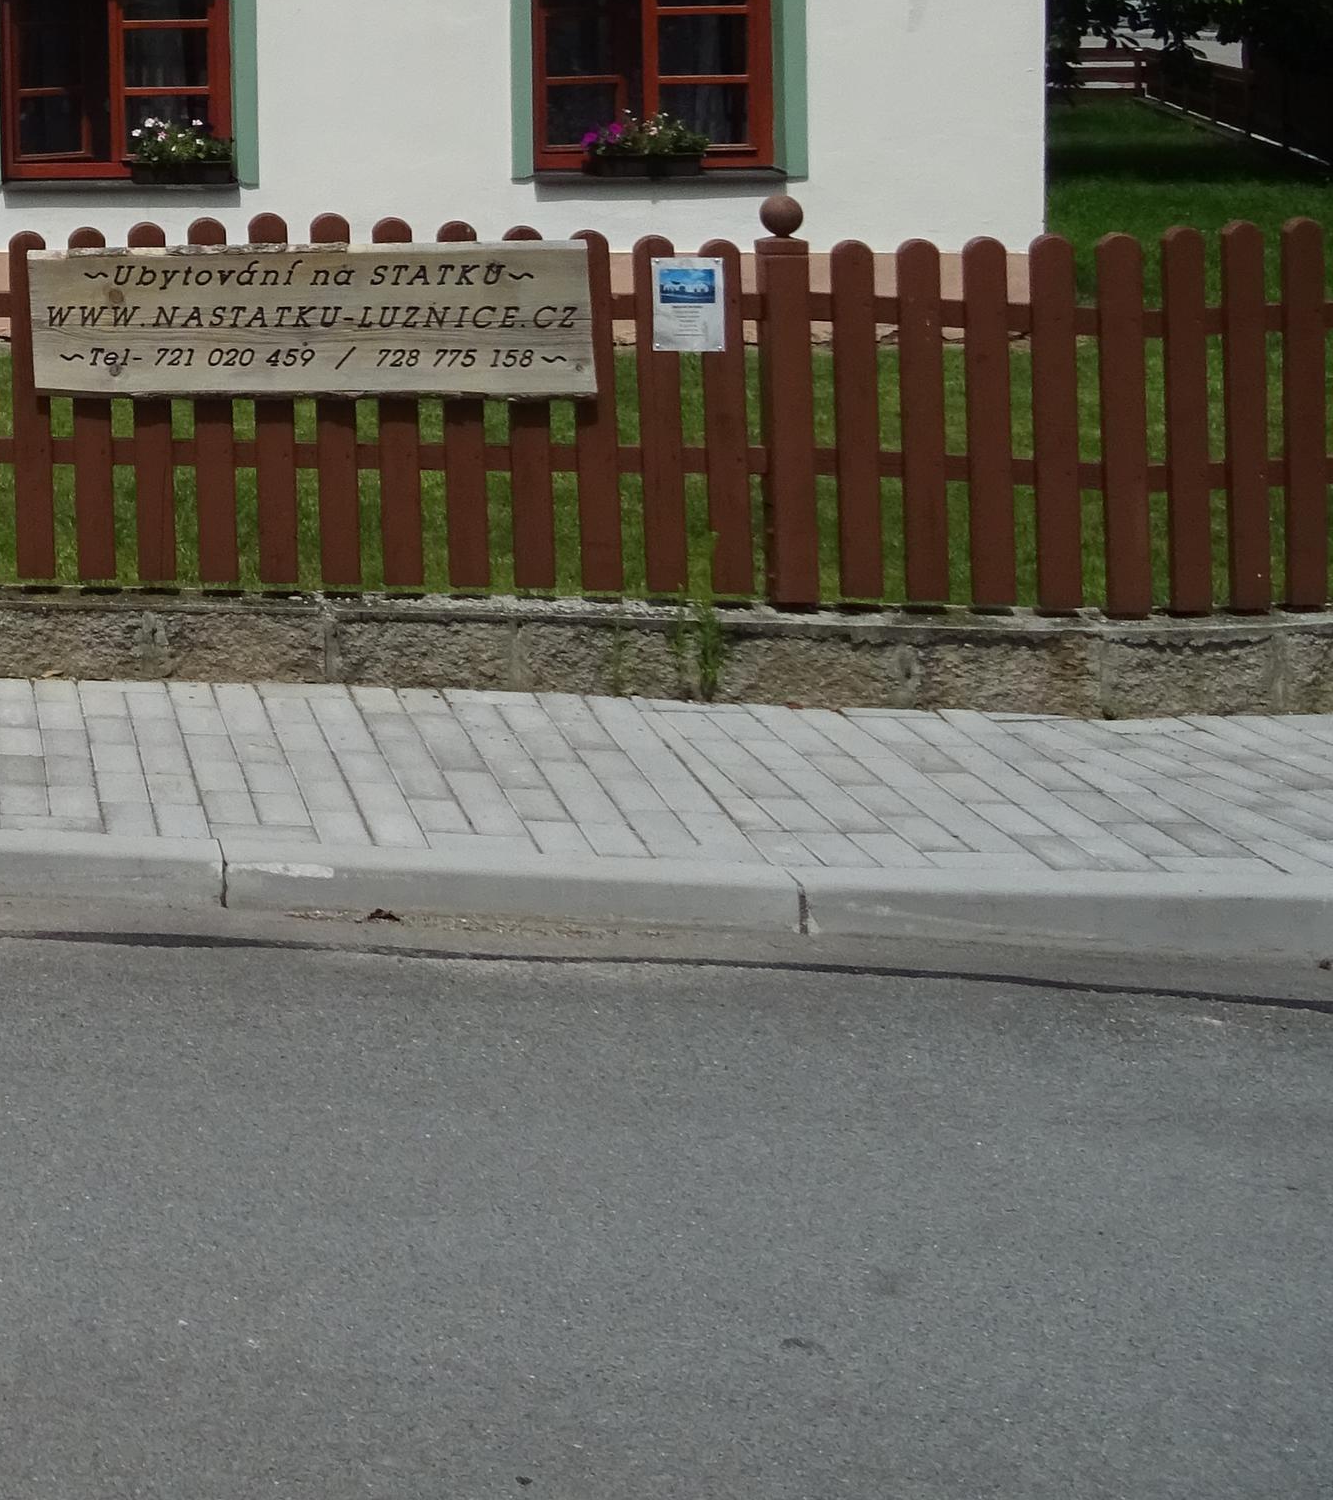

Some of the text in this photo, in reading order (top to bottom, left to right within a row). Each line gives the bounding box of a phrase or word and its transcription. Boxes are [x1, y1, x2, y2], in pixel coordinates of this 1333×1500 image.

[112, 259, 304, 291] Ubytování
[309, 268, 356, 286] na
[46, 304, 579, 329] WWW.NASTATKU-LUZNICE.CZ
[154, 347, 195, 367] 721
[207, 347, 255, 367] 020
[265, 348, 316, 368] 459
[375, 348, 421, 368] 728
[432, 348, 477, 368] 775
[489, 348, 535, 368] 158
